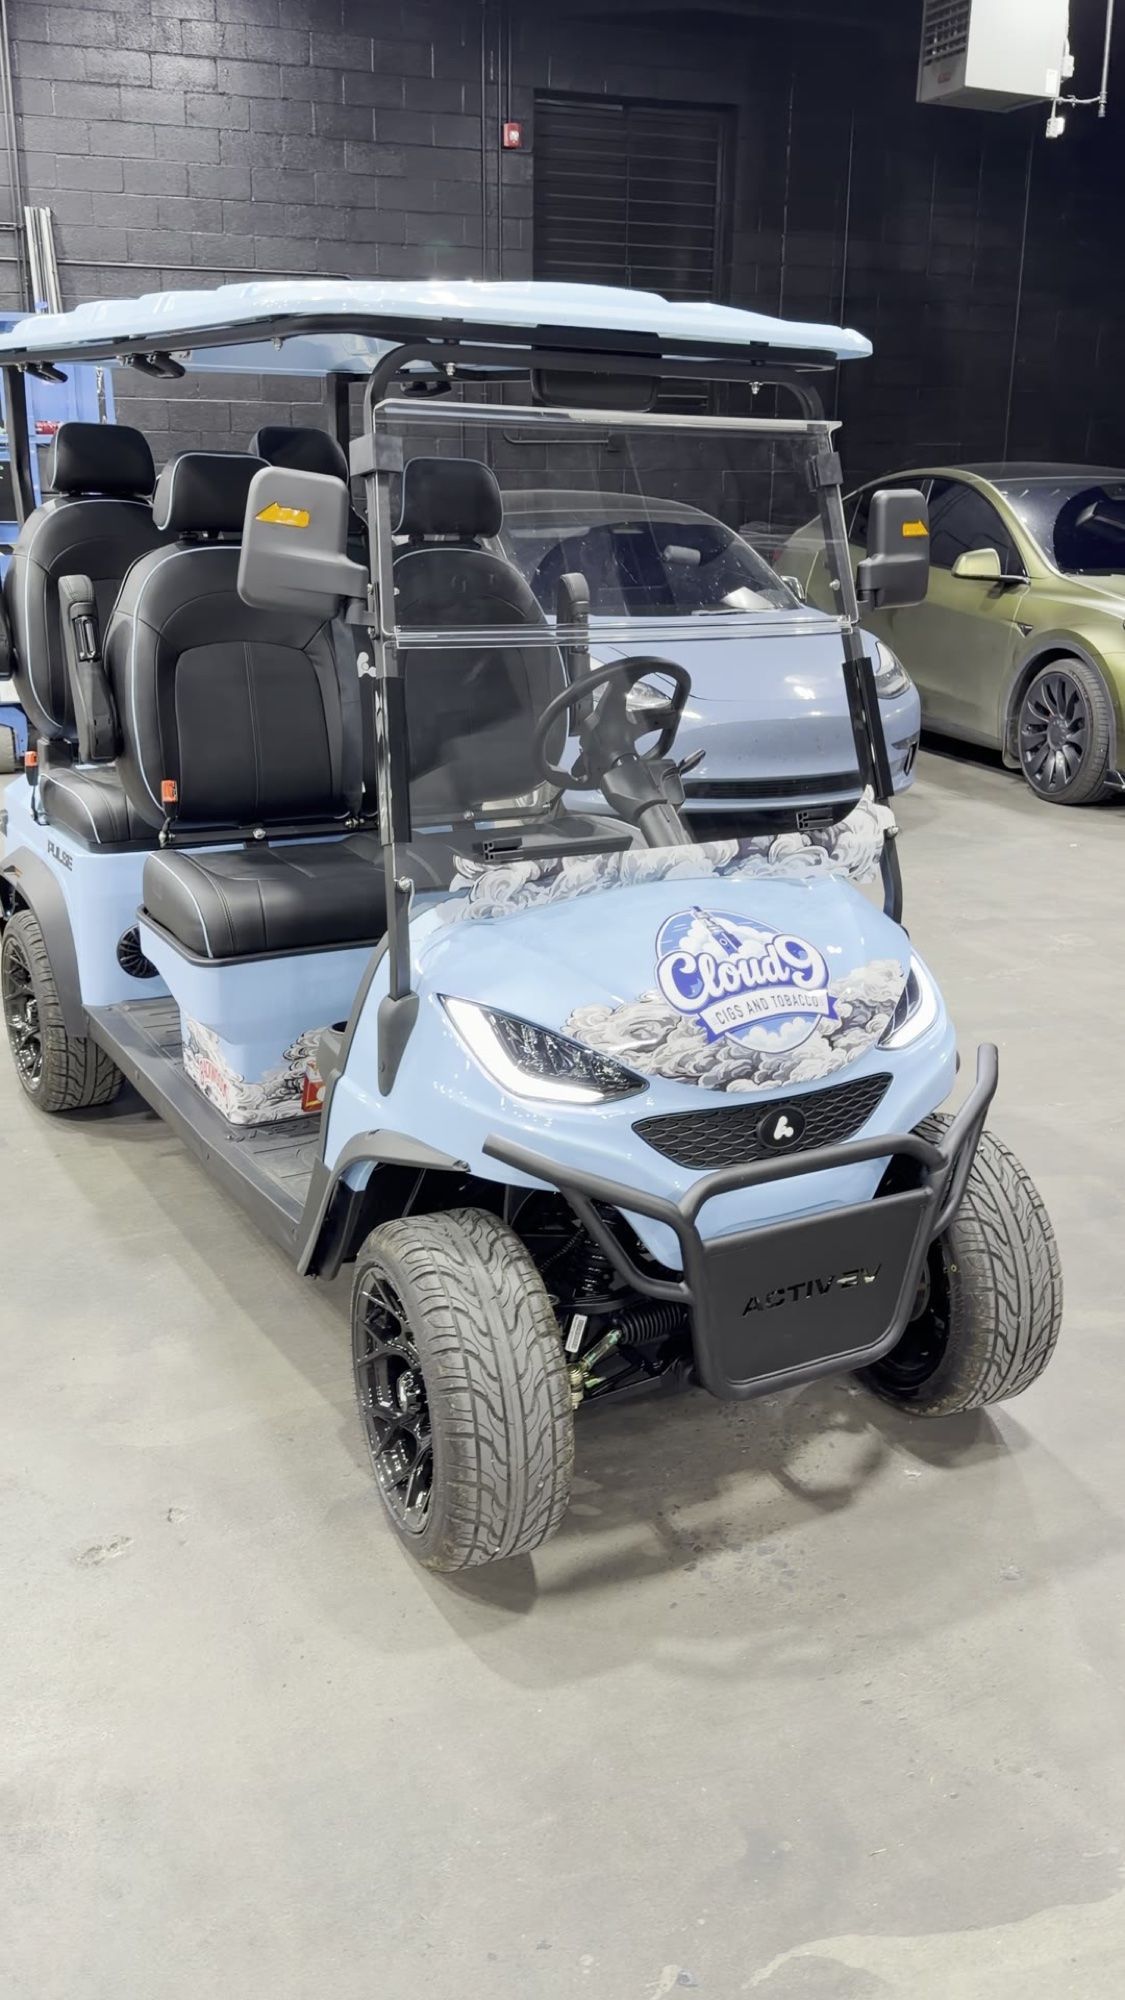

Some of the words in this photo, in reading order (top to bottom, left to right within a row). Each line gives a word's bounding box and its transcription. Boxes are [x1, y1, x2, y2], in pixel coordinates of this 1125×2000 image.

[715, 1000, 744, 1025] CIGS
[747, 997, 769, 1013] AND
[771, 994, 819, 1009] TOBACCO
